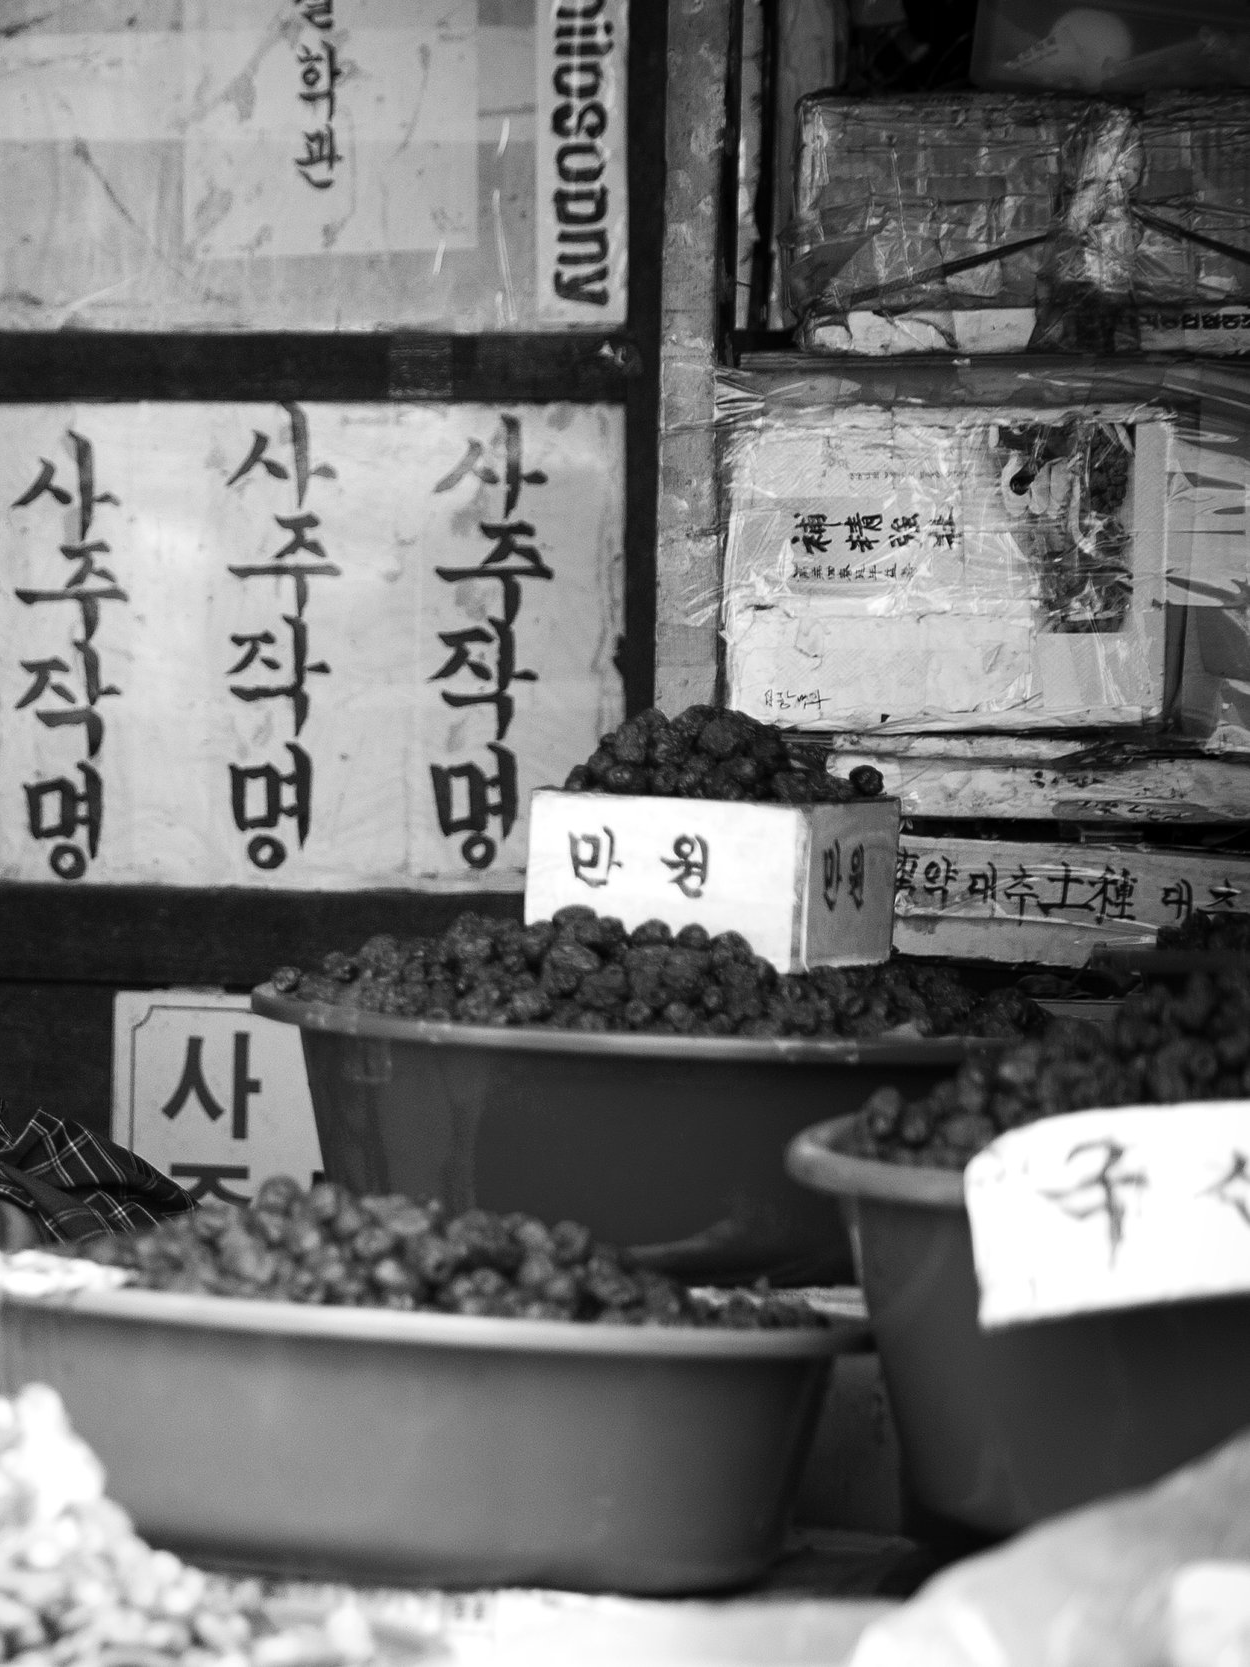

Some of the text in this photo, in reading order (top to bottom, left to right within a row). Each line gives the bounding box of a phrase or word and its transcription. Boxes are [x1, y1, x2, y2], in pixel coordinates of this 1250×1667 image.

[11, 430, 129, 881] 사주작명
[226, 400, 344, 870] 사주작명
[428, 414, 554, 869] 사주작명
